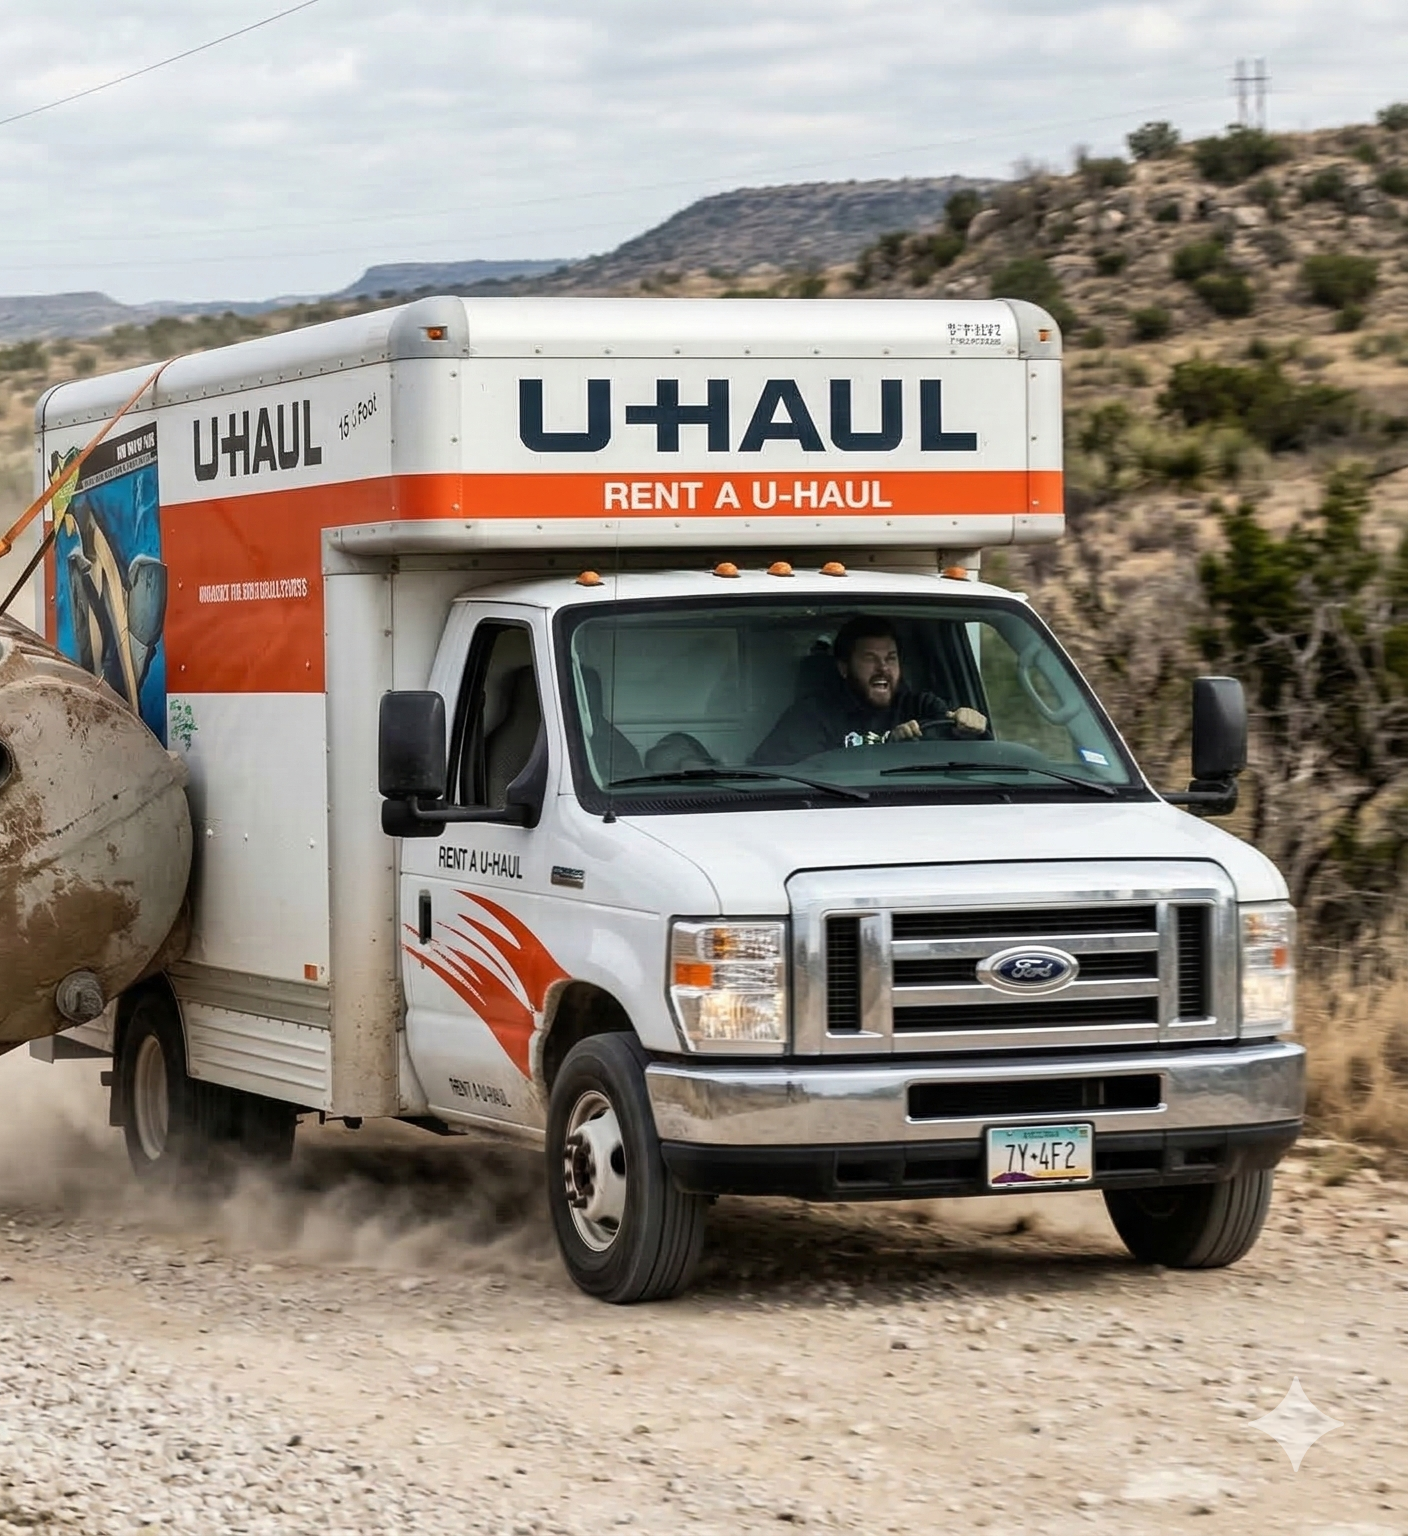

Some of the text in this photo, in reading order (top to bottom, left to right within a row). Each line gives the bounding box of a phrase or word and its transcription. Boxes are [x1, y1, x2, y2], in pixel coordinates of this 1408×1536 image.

[518, 378, 978, 453] U-HAUL
[193, 399, 323, 482] U-HAUL
[603, 479, 893, 510] RENT A U-HAUL
[438, 845, 523, 880] RENT A U-HAUL
[1010, 958, 1054, 978] Ford
